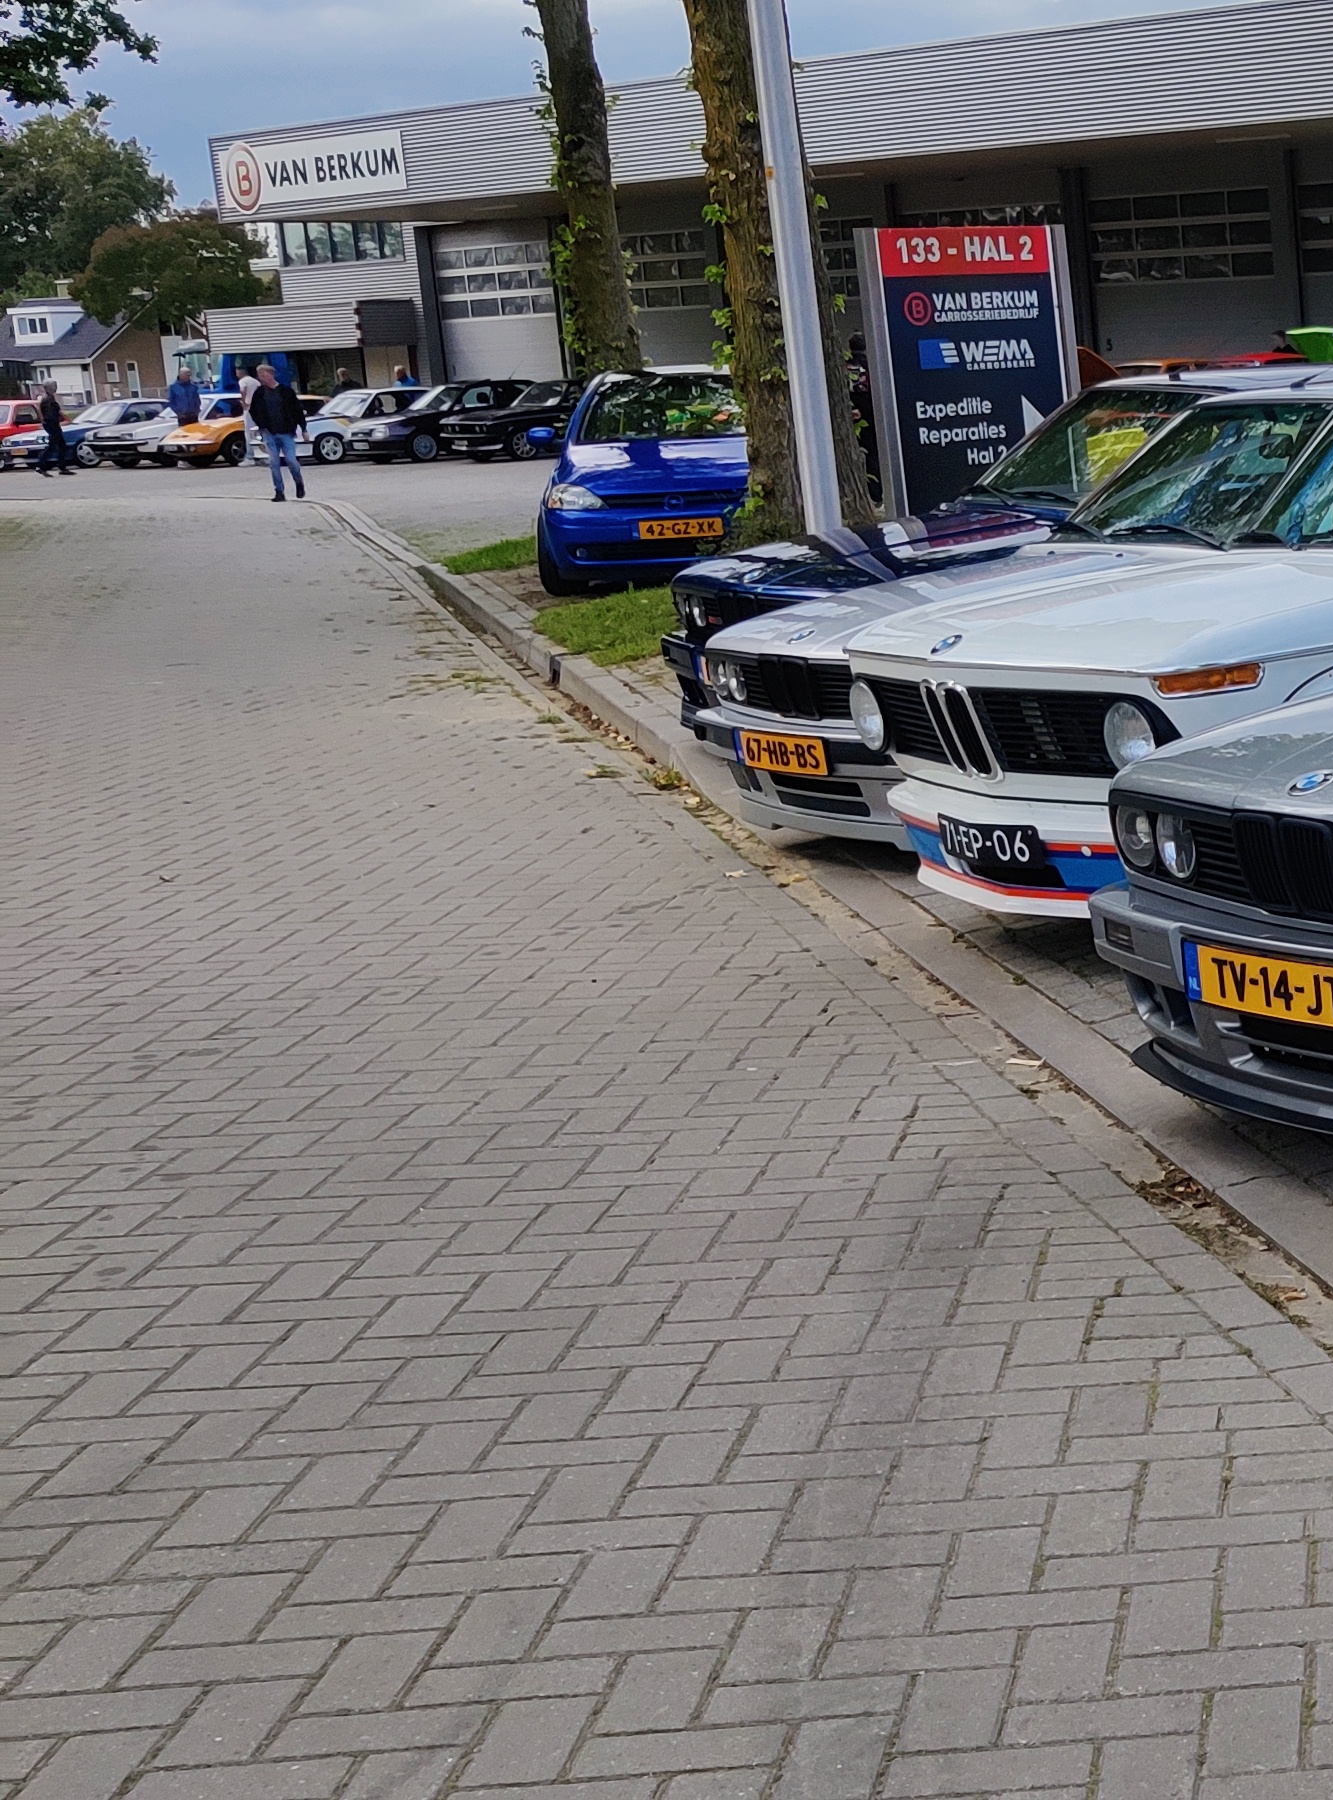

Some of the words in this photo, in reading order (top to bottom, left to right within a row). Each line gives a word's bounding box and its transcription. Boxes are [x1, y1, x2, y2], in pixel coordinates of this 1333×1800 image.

[235, 160, 253, 197] B
[264, 158, 309, 188] VAN
[314, 147, 401, 183] BERKUM
[896, 236, 941, 264] 133
[963, 235, 1015, 262] HAL
[1018, 235, 1034, 261] 2
[911, 299, 925, 319] B
[931, 292, 967, 311] VAN
[970, 289, 1039, 309] BERKUM
[933, 308, 1040, 323] CARROSSERIEBEDRIJF
[960, 338, 1035, 362] WEMA
[966, 359, 1036, 371] CARROSSERIE
[915, 396, 993, 422] Expeditie
[918, 421, 1007, 447] Reparaties
[966, 448, 995, 466] Hal
[645, 520, 718, 537] 42-GZ-XK
[745, 736, 821, 770] 67-HB-BS
[939, 818, 1030, 863] 71-EP-06
[1188, 975, 1200, 991] NL
